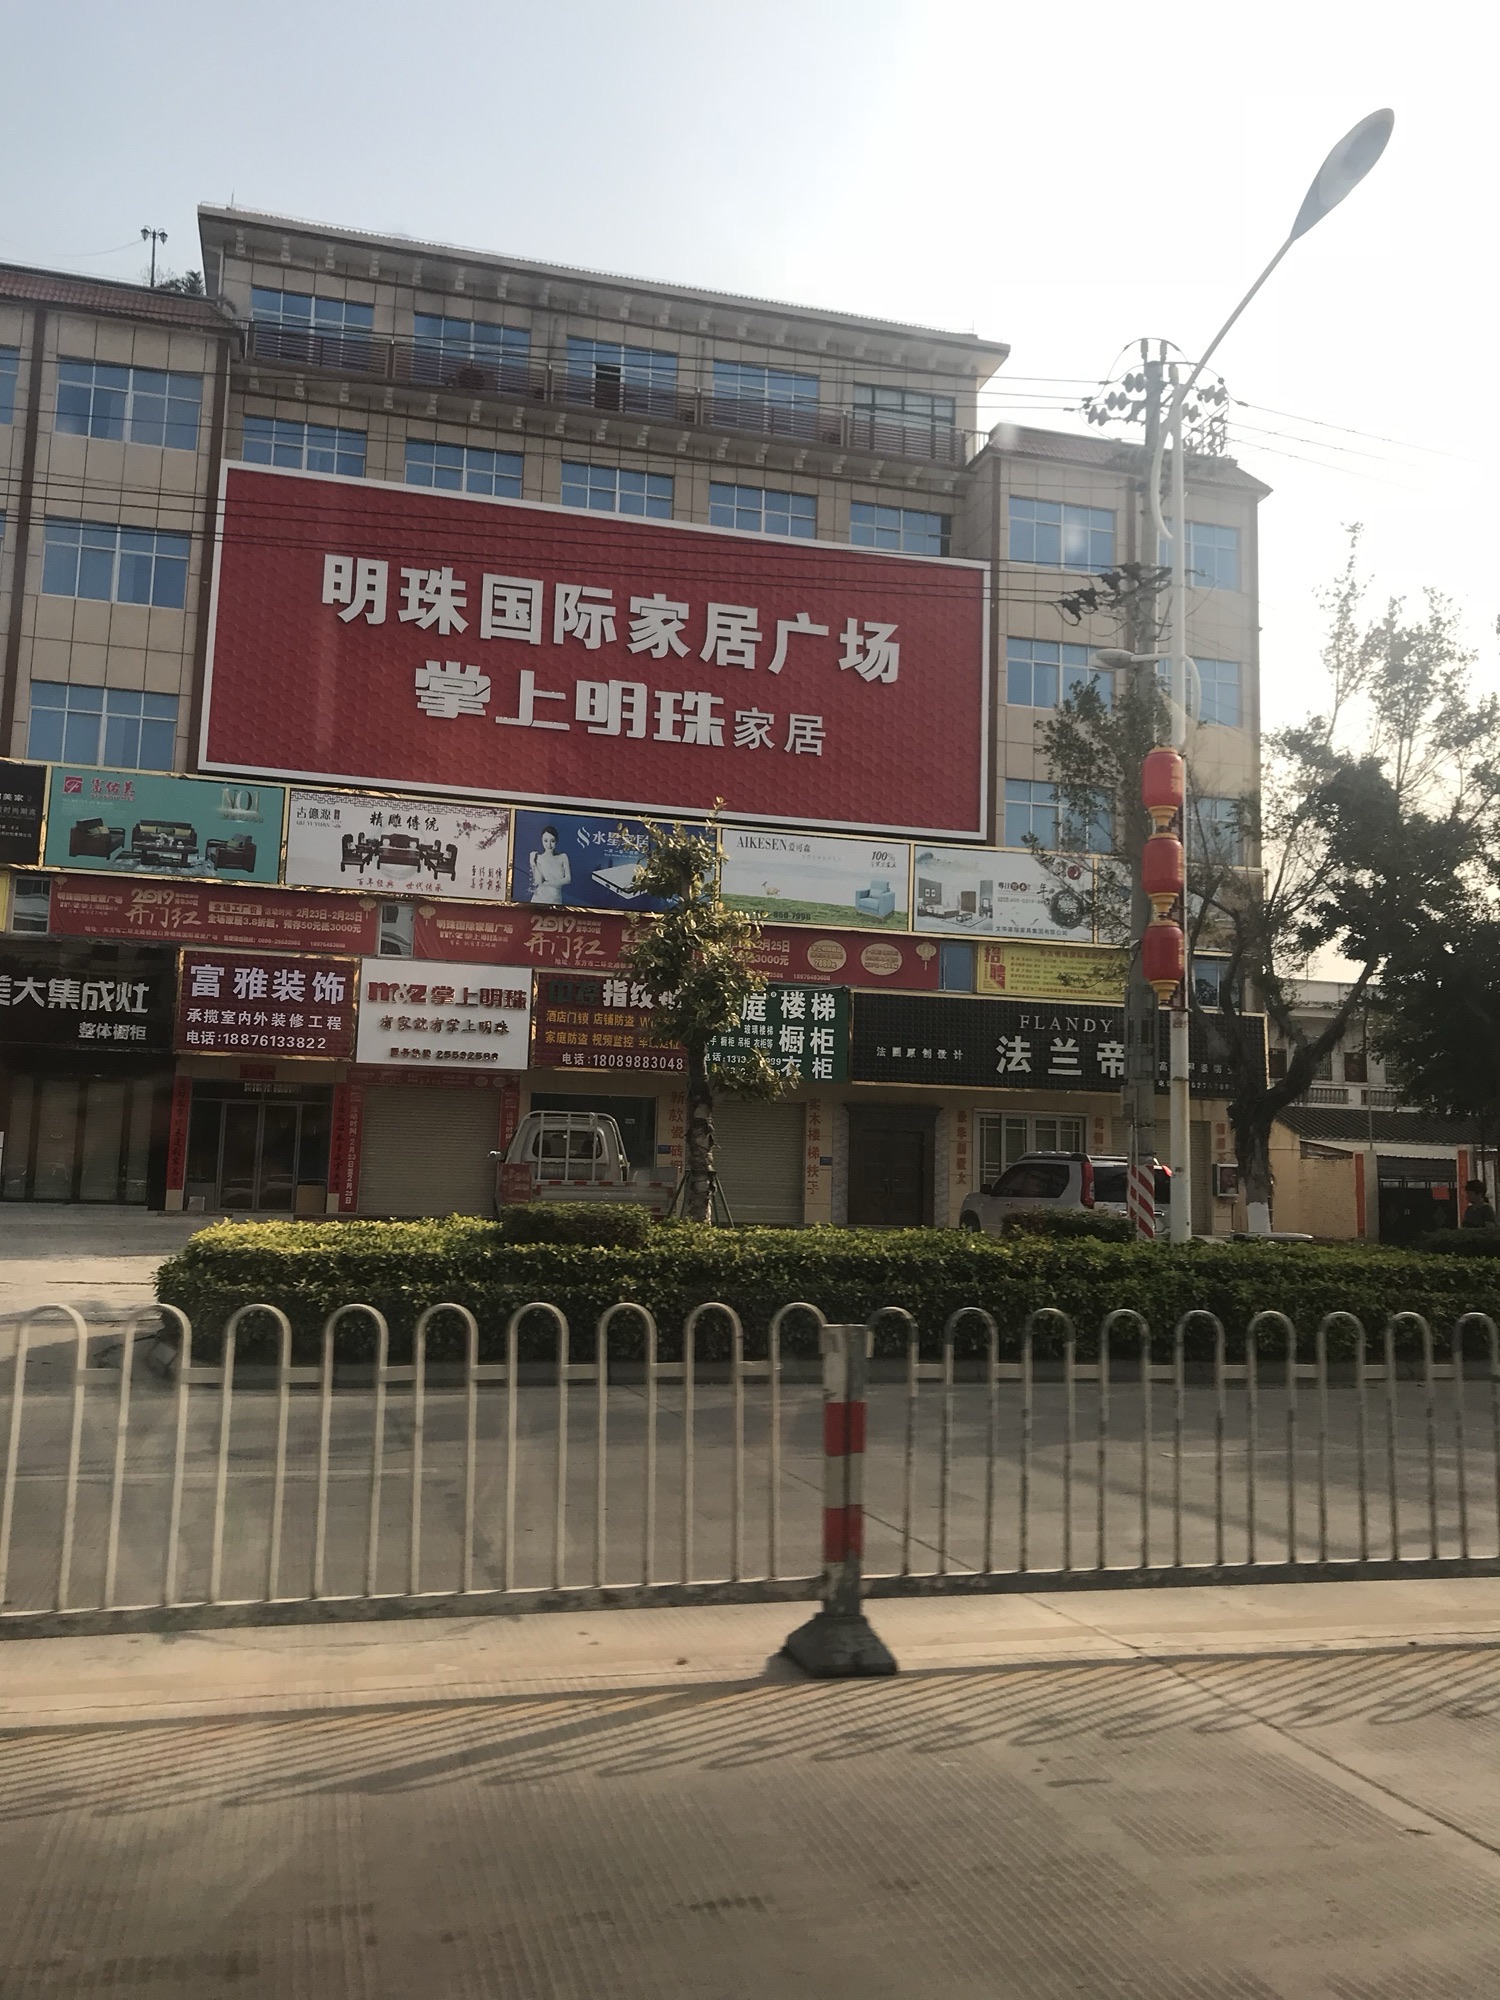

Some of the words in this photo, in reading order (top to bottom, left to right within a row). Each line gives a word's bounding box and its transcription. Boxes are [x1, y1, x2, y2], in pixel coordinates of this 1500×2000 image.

[322, 554, 900, 683] 明珠国际家居广场
[414, 660, 827, 756] 掌上明珠家居
[737, 836, 788, 851] AIKESEN
[131, 888, 174, 905] 2019
[125, 904, 202, 928] 开门红
[530, 915, 576, 933] 2019
[436, 919, 513, 934] 明珠国际家居广场
[524, 933, 606, 959] 开门红
[190, 964, 346, 1005] 富雅装饰
[780, 991, 836, 1022] 楼梯
[186, 1008, 342, 1030] 承揽室内外装修工程
[379, 1014, 510, 1035] 有家就有掌上明珠
[546, 1010, 589, 1025] 酒店门锁
[593, 1013, 635, 1028] 店铺防盗
[1019, 1014, 1114, 1034] FLANDY
[78, 1021, 147, 1041] 整体橱柜
[186, 1031, 327, 1049] 电话:18876133822
[545, 1030, 588, 1046] 家庭防盗
[592, 1033, 634, 1048] 视频监控
[744, 1024, 774, 1036] 玻璃楼梯
[778, 1024, 835, 1055] 橱柜
[720, 1036, 735, 1047] 橱柜
[738, 1037, 751, 1048] 吊柜
[753, 1038, 774, 1050] 衣柜等
[562, 1052, 684, 1070] 电话:18089883048
[876, 1046, 964, 1061] 法国原创设计
[995, 1035, 1125, 1079] 法兰帝
